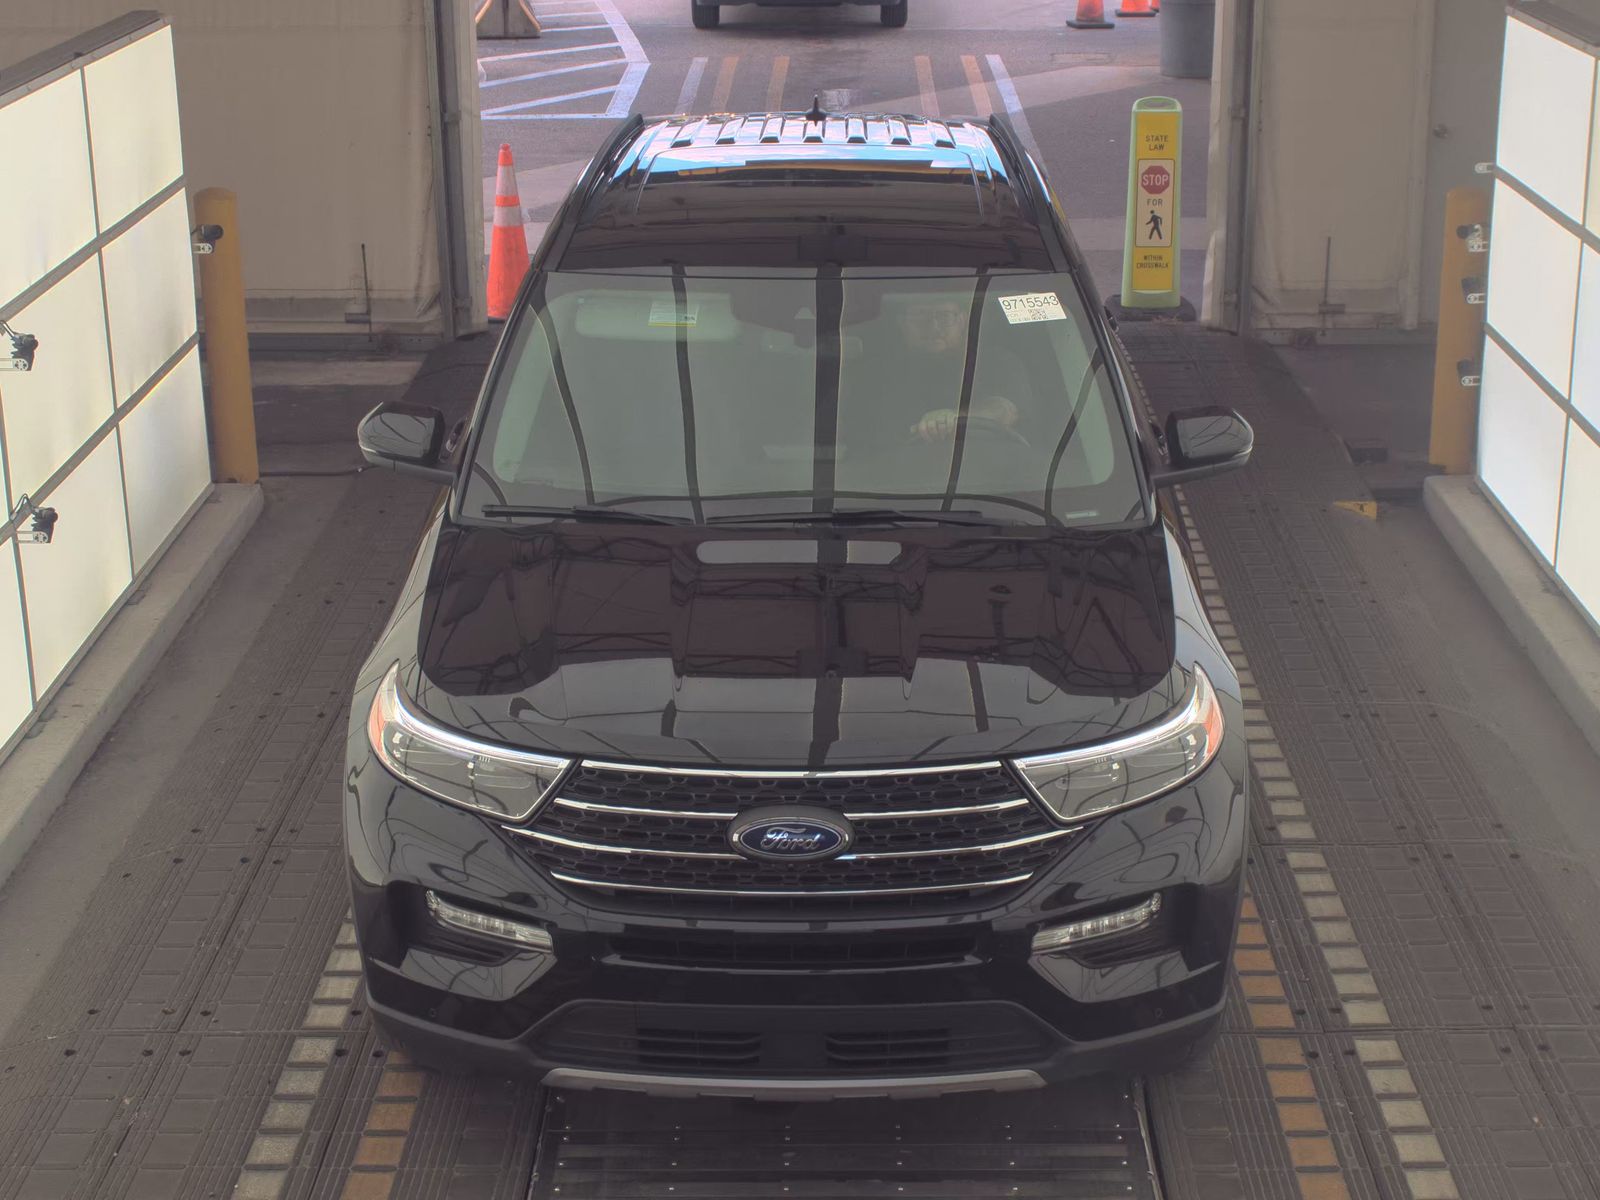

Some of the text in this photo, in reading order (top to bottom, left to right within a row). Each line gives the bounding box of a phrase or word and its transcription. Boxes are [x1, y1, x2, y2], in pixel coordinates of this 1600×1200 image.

[1145, 134, 1168, 143] STATE
[1149, 143, 1164, 151] LAW
[1142, 174, 1169, 186] STOP
[1147, 198, 1163, 207] FOR
[1143, 254, 1163, 262] WITHIN
[1002, 295, 1059, 310] 9715543
[760, 826, 821, 851] Ford
